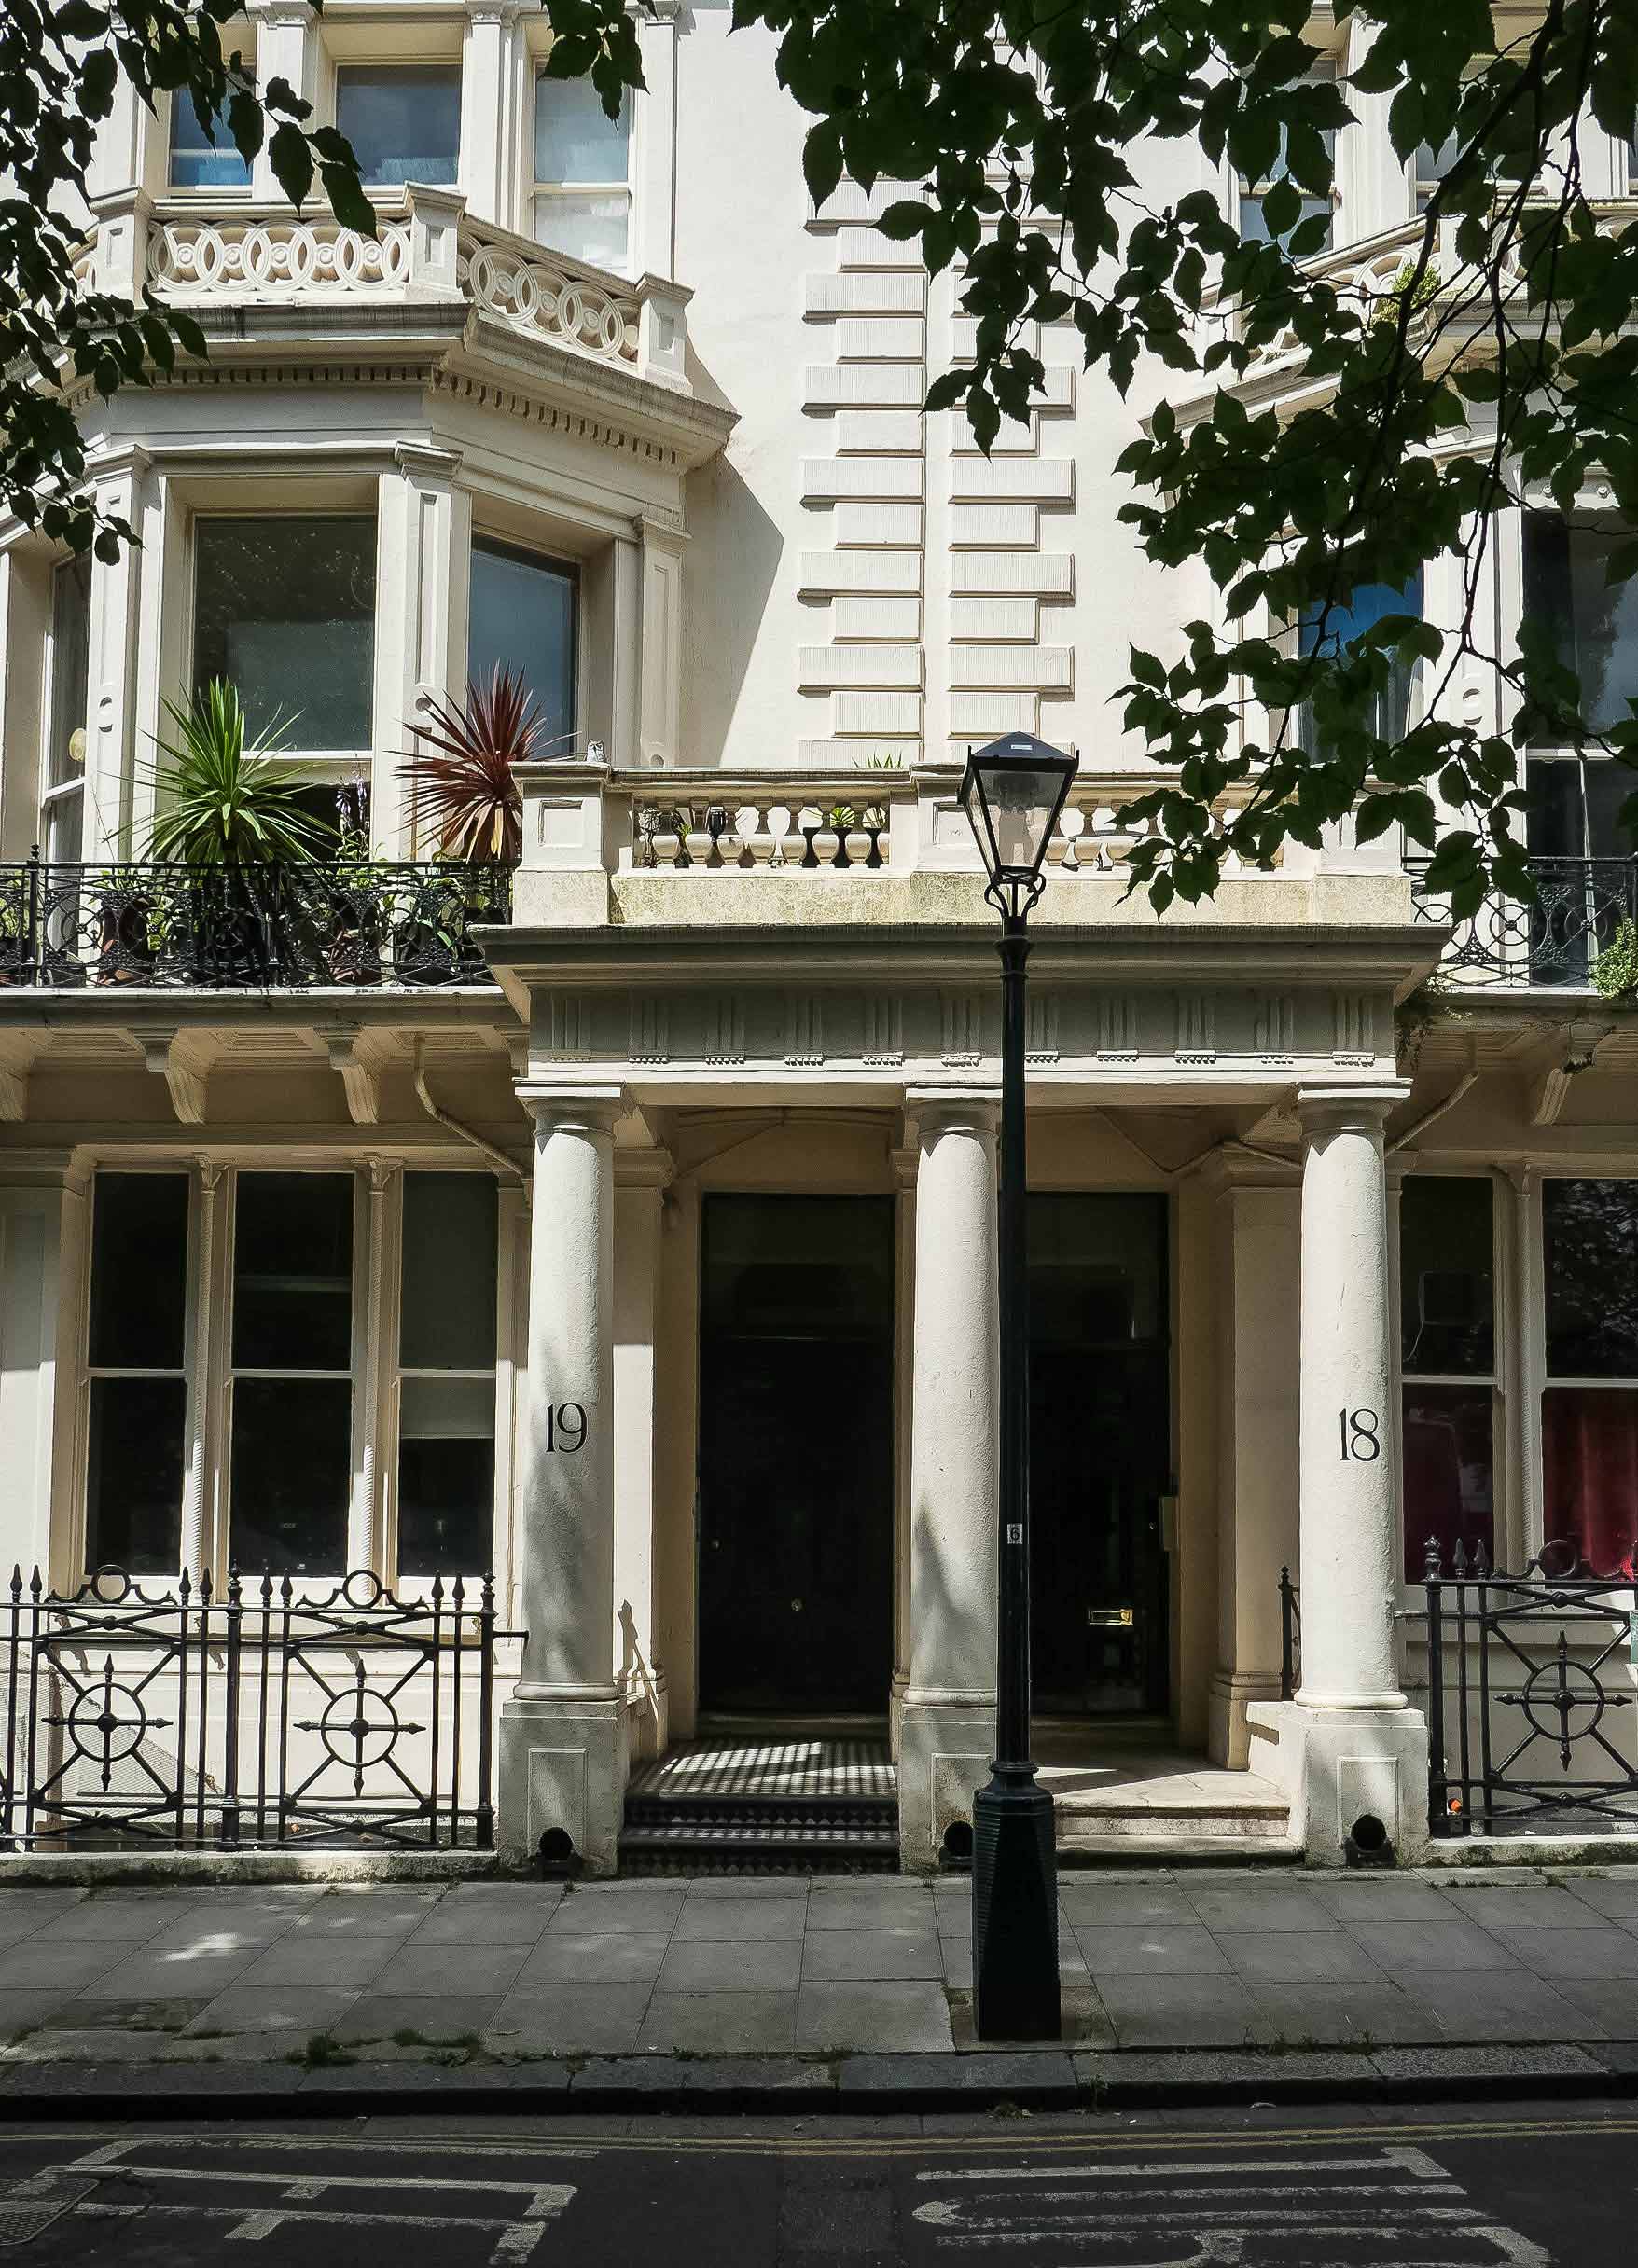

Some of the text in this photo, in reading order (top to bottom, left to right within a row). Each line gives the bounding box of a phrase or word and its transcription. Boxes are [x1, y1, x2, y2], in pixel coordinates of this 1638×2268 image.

[546, 1402, 588, 1453] 19
[1339, 1408, 1381, 1461] 18
[1010, 1527, 1020, 1541] 6
